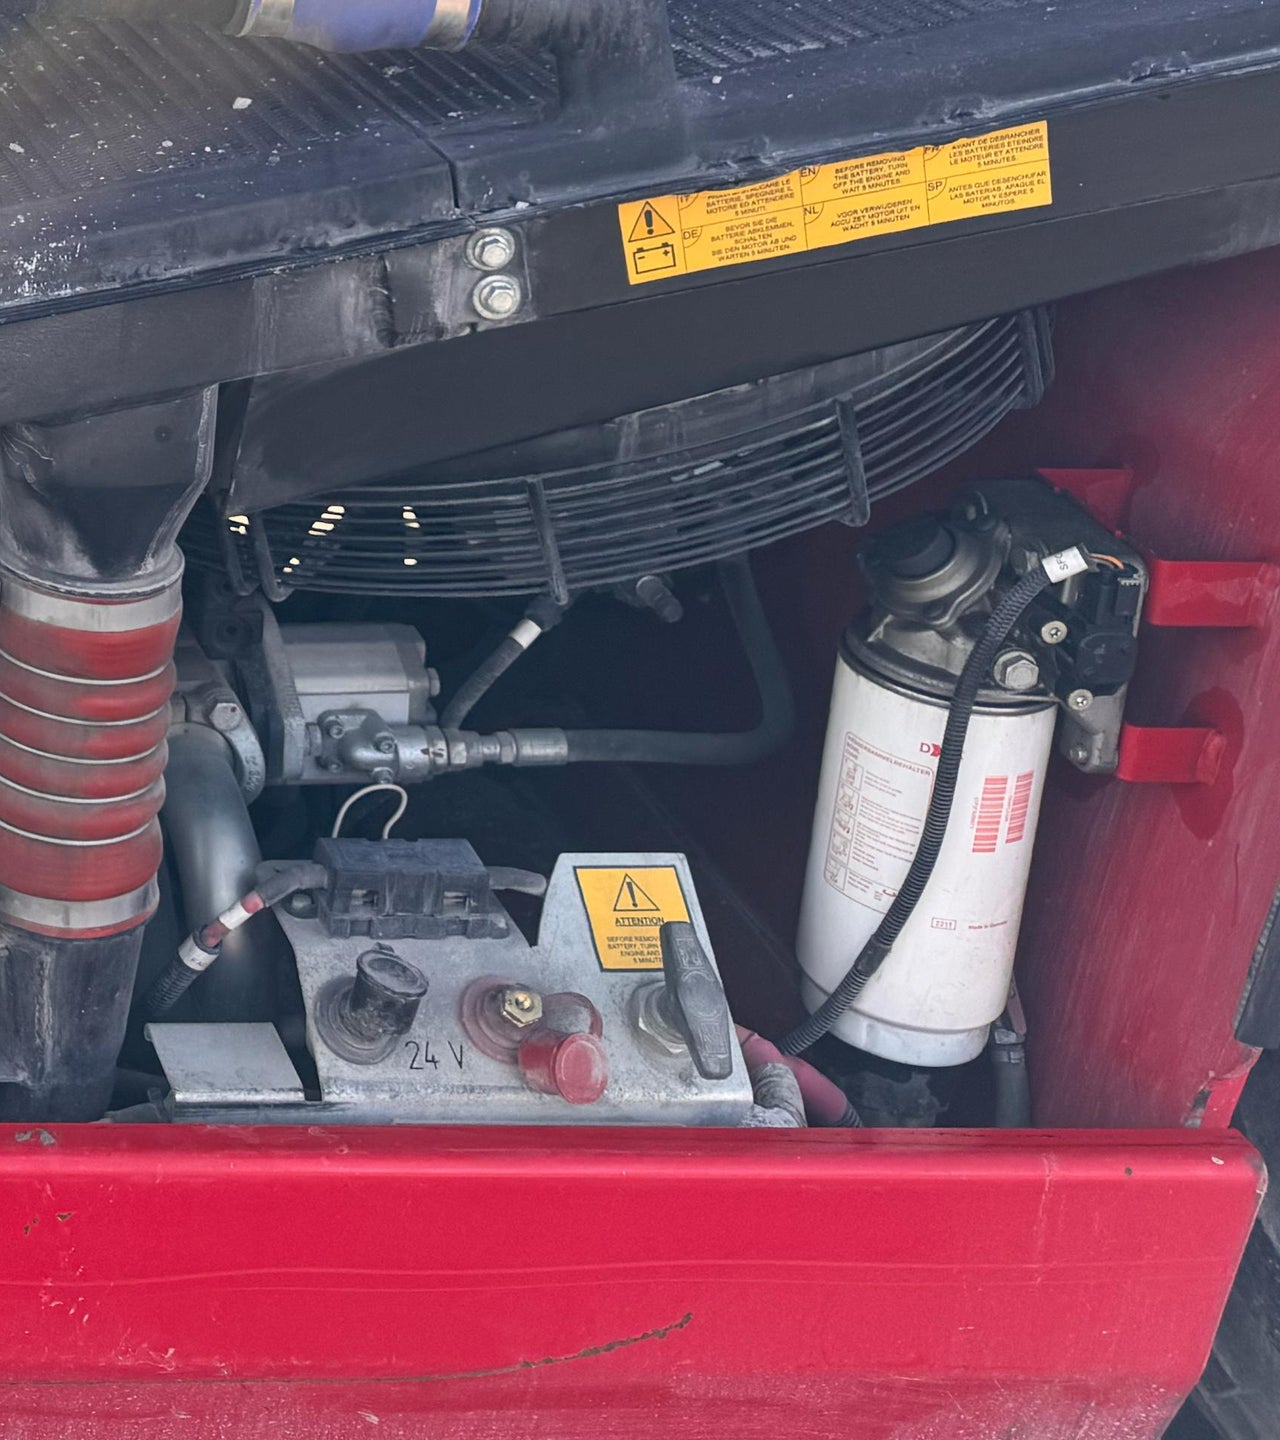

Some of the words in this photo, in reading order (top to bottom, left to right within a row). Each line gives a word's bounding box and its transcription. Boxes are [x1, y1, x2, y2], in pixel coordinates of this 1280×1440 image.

[952, 140, 976, 150] AVANT
[989, 128, 1041, 143] DEBRANCHER
[949, 151, 963, 159] LES
[965, 143, 1004, 155] BATTERIES
[1007, 135, 1044, 146] ETEINDRE
[960, 153, 992, 164] MOTEUR
[1005, 143, 1044, 155] ATTENDRE
[835, 163, 865, 174] BEFORE
[866, 155, 906, 168] REMOVING
[888, 163, 908, 171] TURN
[800, 167, 816, 178] EN
[833, 182, 847, 190] OFF
[866, 173, 892, 184] ENGINE
[895, 169, 910, 177] AND
[948, 184, 973, 193] ANTES
[974, 180, 990, 189] QUE
[991, 171, 1046, 186] DESENCHUFAR
[841, 186, 860, 195] WAIT
[927, 181, 943, 192] SP
[950, 192, 964, 200] LAS
[963, 195, 991, 204] MOTOR
[999, 189, 1028, 198] ESPERE
[707, 203, 739, 215] MOTORE
[751, 193, 795, 206] ATTENDERE
[804, 206, 819, 215] NL
[831, 219, 851, 227] ACCU
[868, 210, 895, 220] MOTOR
[896, 206, 908, 214] UIT
[837, 209, 859, 218] VOOR
[725, 222, 751, 232] BEVOR
[752, 219, 765, 227] SIE
[766, 216, 778, 224] DIE
[842, 222, 869, 232] WACHT
[683, 229, 699, 241] DE
[711, 230, 746, 242] BATTERIE
[734, 233, 773, 245] SCHALTEN
[725, 246, 740, 254] DEN
[741, 240, 768, 251] MOTOR
[781, 234, 797, 243] UND
[718, 250, 750, 262] WARTEN
[615, 917, 664, 926] ATTENTION
[405, 1040, 439, 1070] 24
[448, 1040, 463, 1069] V
